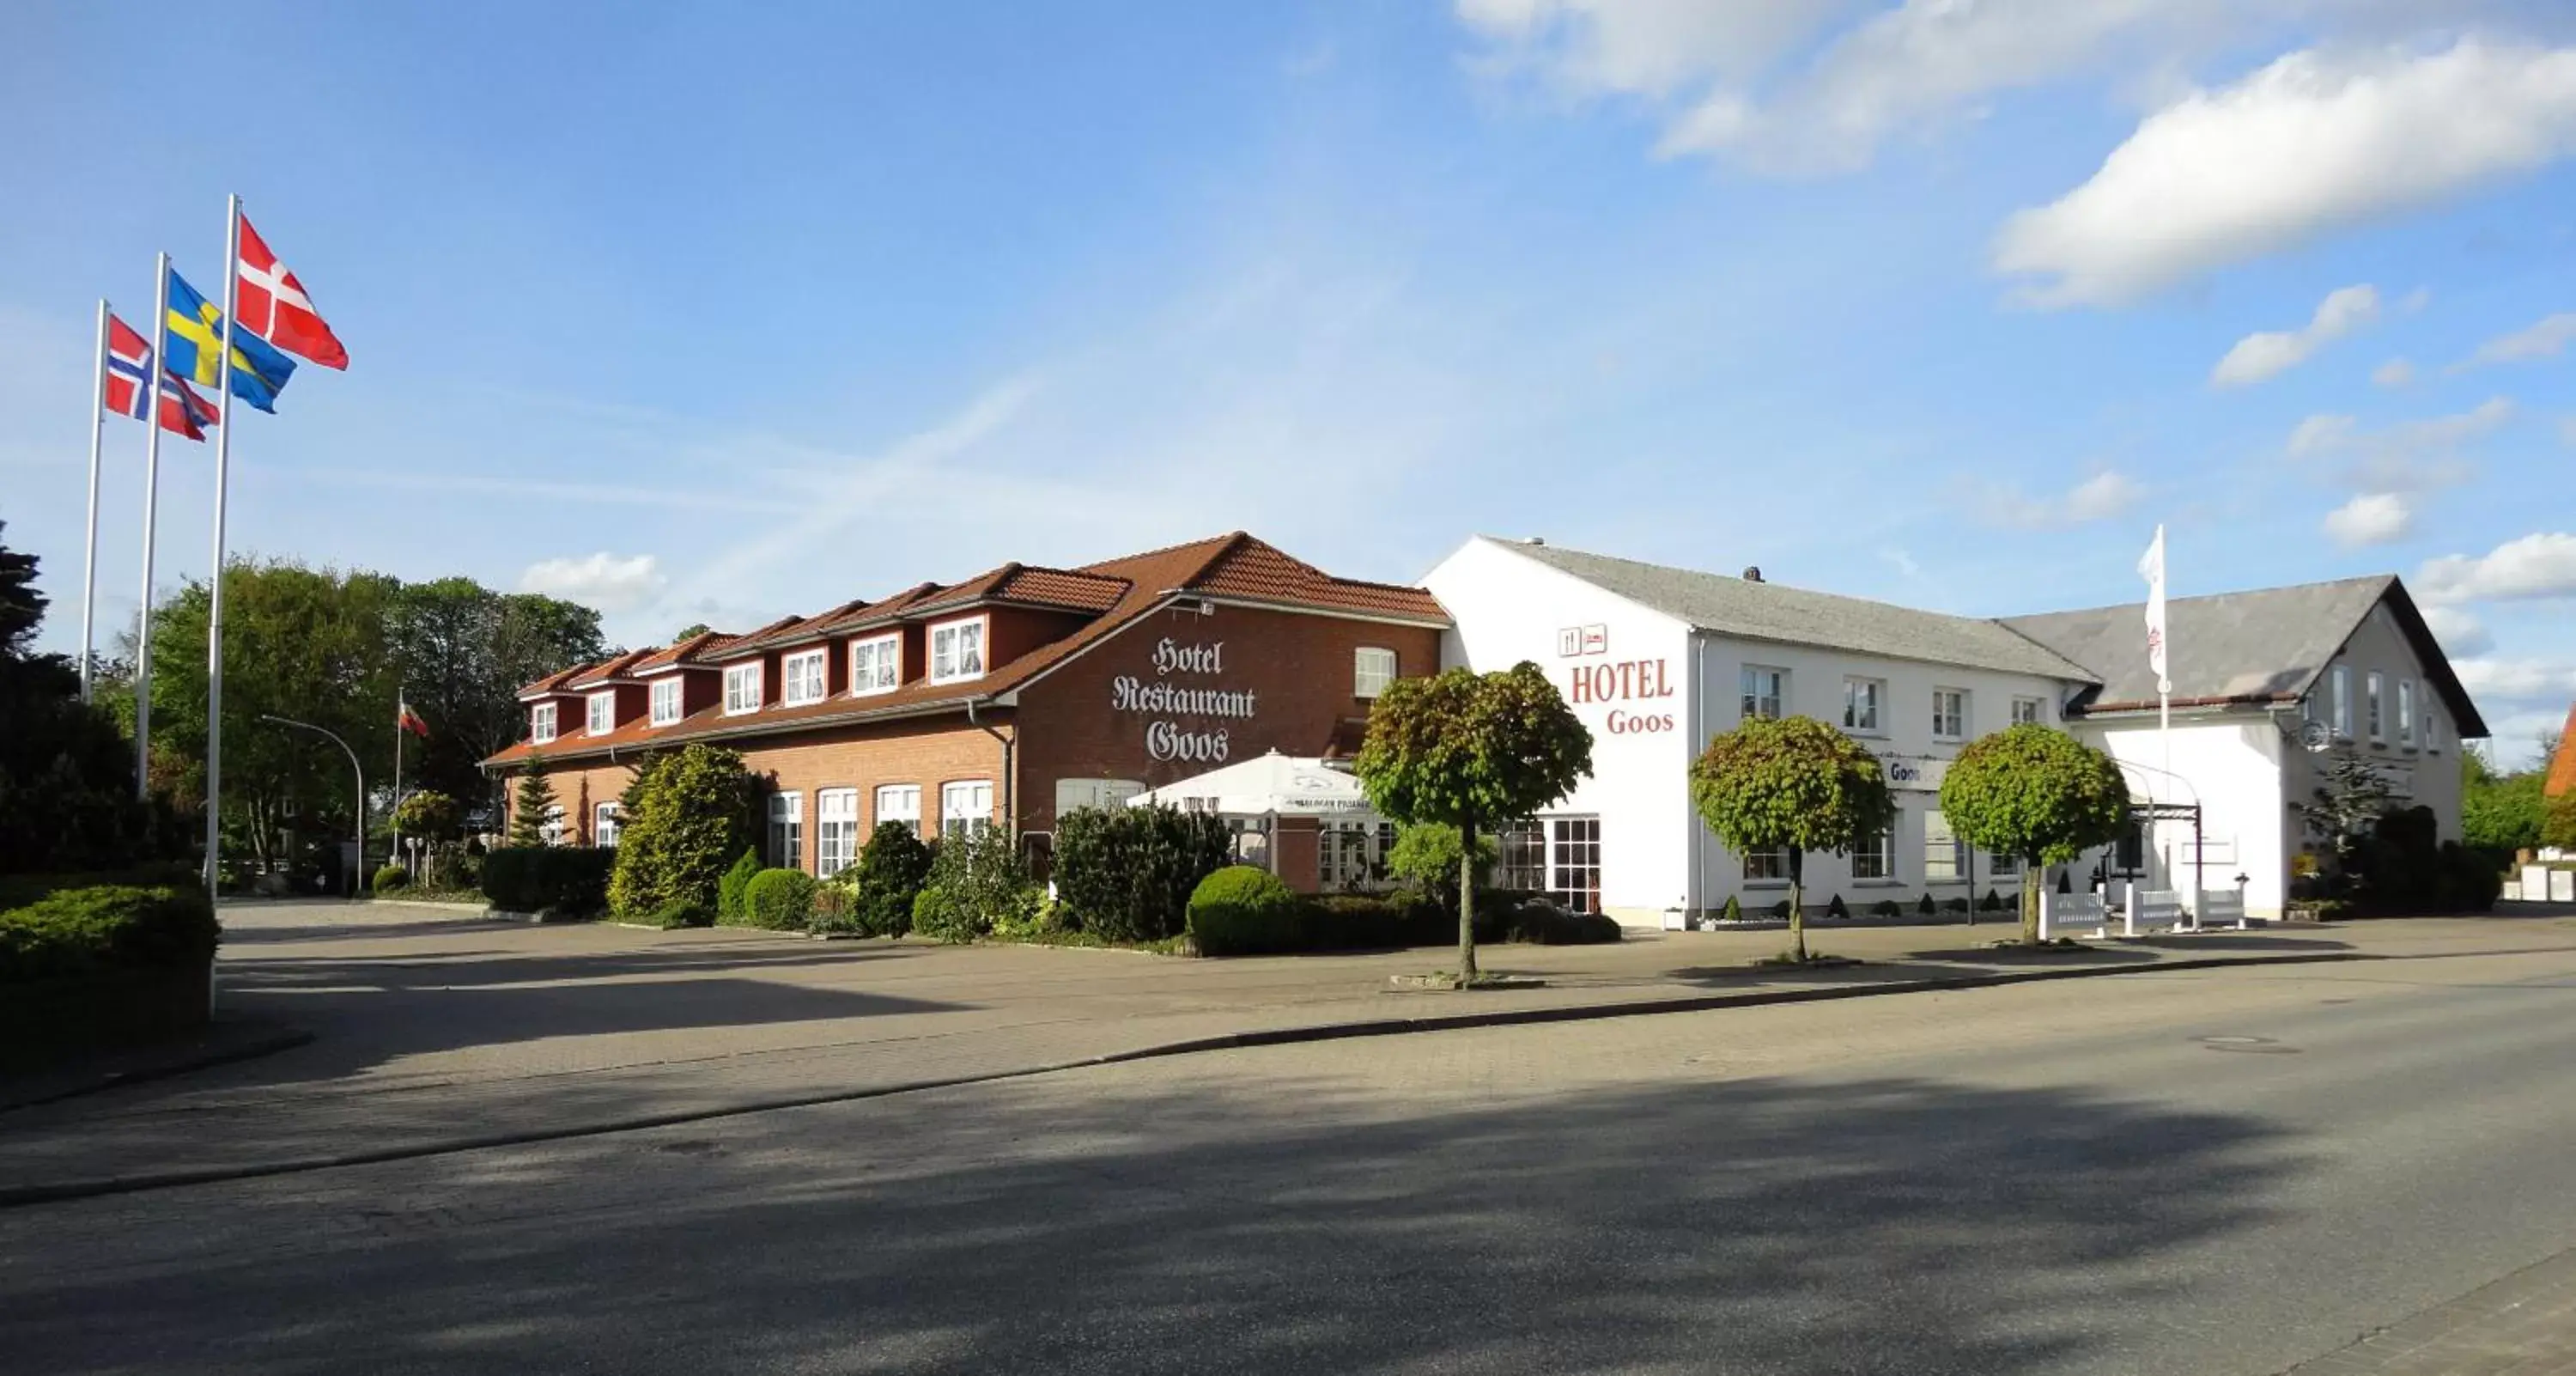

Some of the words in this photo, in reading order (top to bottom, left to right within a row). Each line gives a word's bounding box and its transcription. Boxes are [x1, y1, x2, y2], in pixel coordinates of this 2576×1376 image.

[1151, 636, 1224, 676] Hotel
[1113, 675, 1256, 718] Restaurant
[1571, 658, 1674, 703] HOTEL
[1146, 721, 1229, 763] Goos
[1607, 709, 1674, 734] Goos
[1891, 762, 1921, 781] Goo
